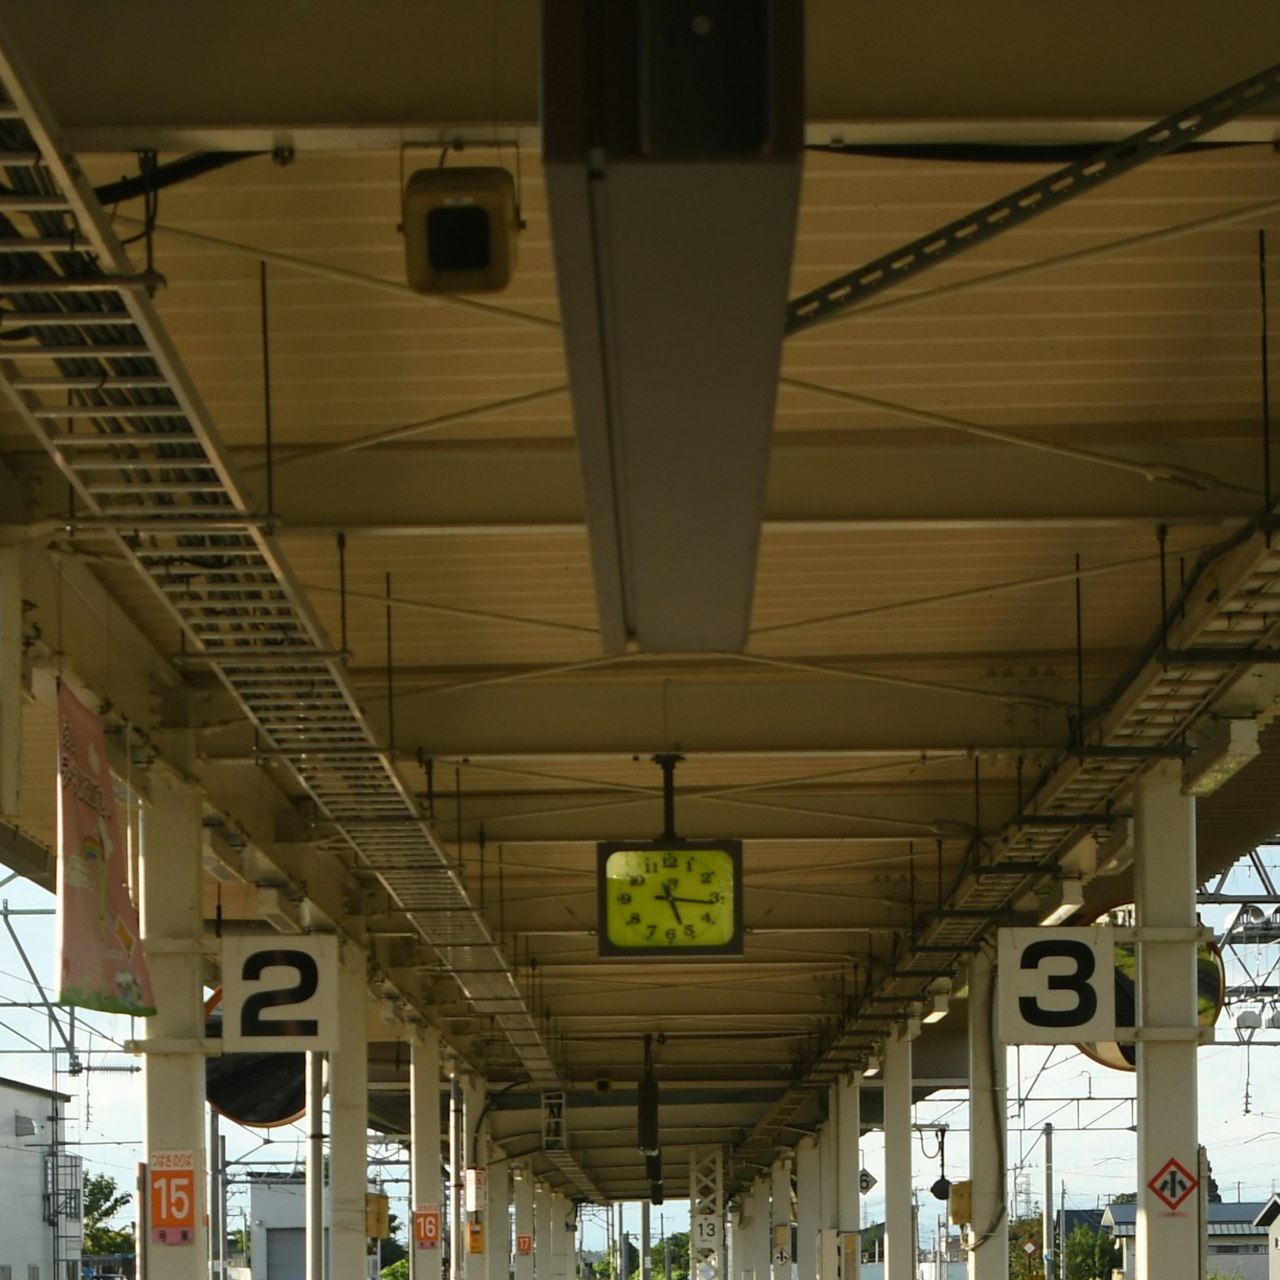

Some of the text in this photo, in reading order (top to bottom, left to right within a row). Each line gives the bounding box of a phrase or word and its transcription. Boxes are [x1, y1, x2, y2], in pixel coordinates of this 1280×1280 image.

[645, 862, 658, 873] 11
[663, 857, 678, 868] 12
[686, 860, 692, 872] 1
[630, 875, 645, 886] 10
[701, 873, 711, 884] 2
[620, 893, 631, 904] 9
[709, 892, 720, 904] 3
[630, 913, 641, 924] 8
[701, 912, 711, 924] 4
[647, 925, 657, 937] 7
[665, 928, 676, 940] 6
[684, 925, 694, 936] 5
[1018, 939, 1098, 1027] 3
[240, 948, 319, 1037] 2
[152, 1176, 190, 1220] 15
[416, 1216, 436, 1238] 16
[697, 1223, 716, 1237] 13
[518, 1238, 528, 1250] 17
